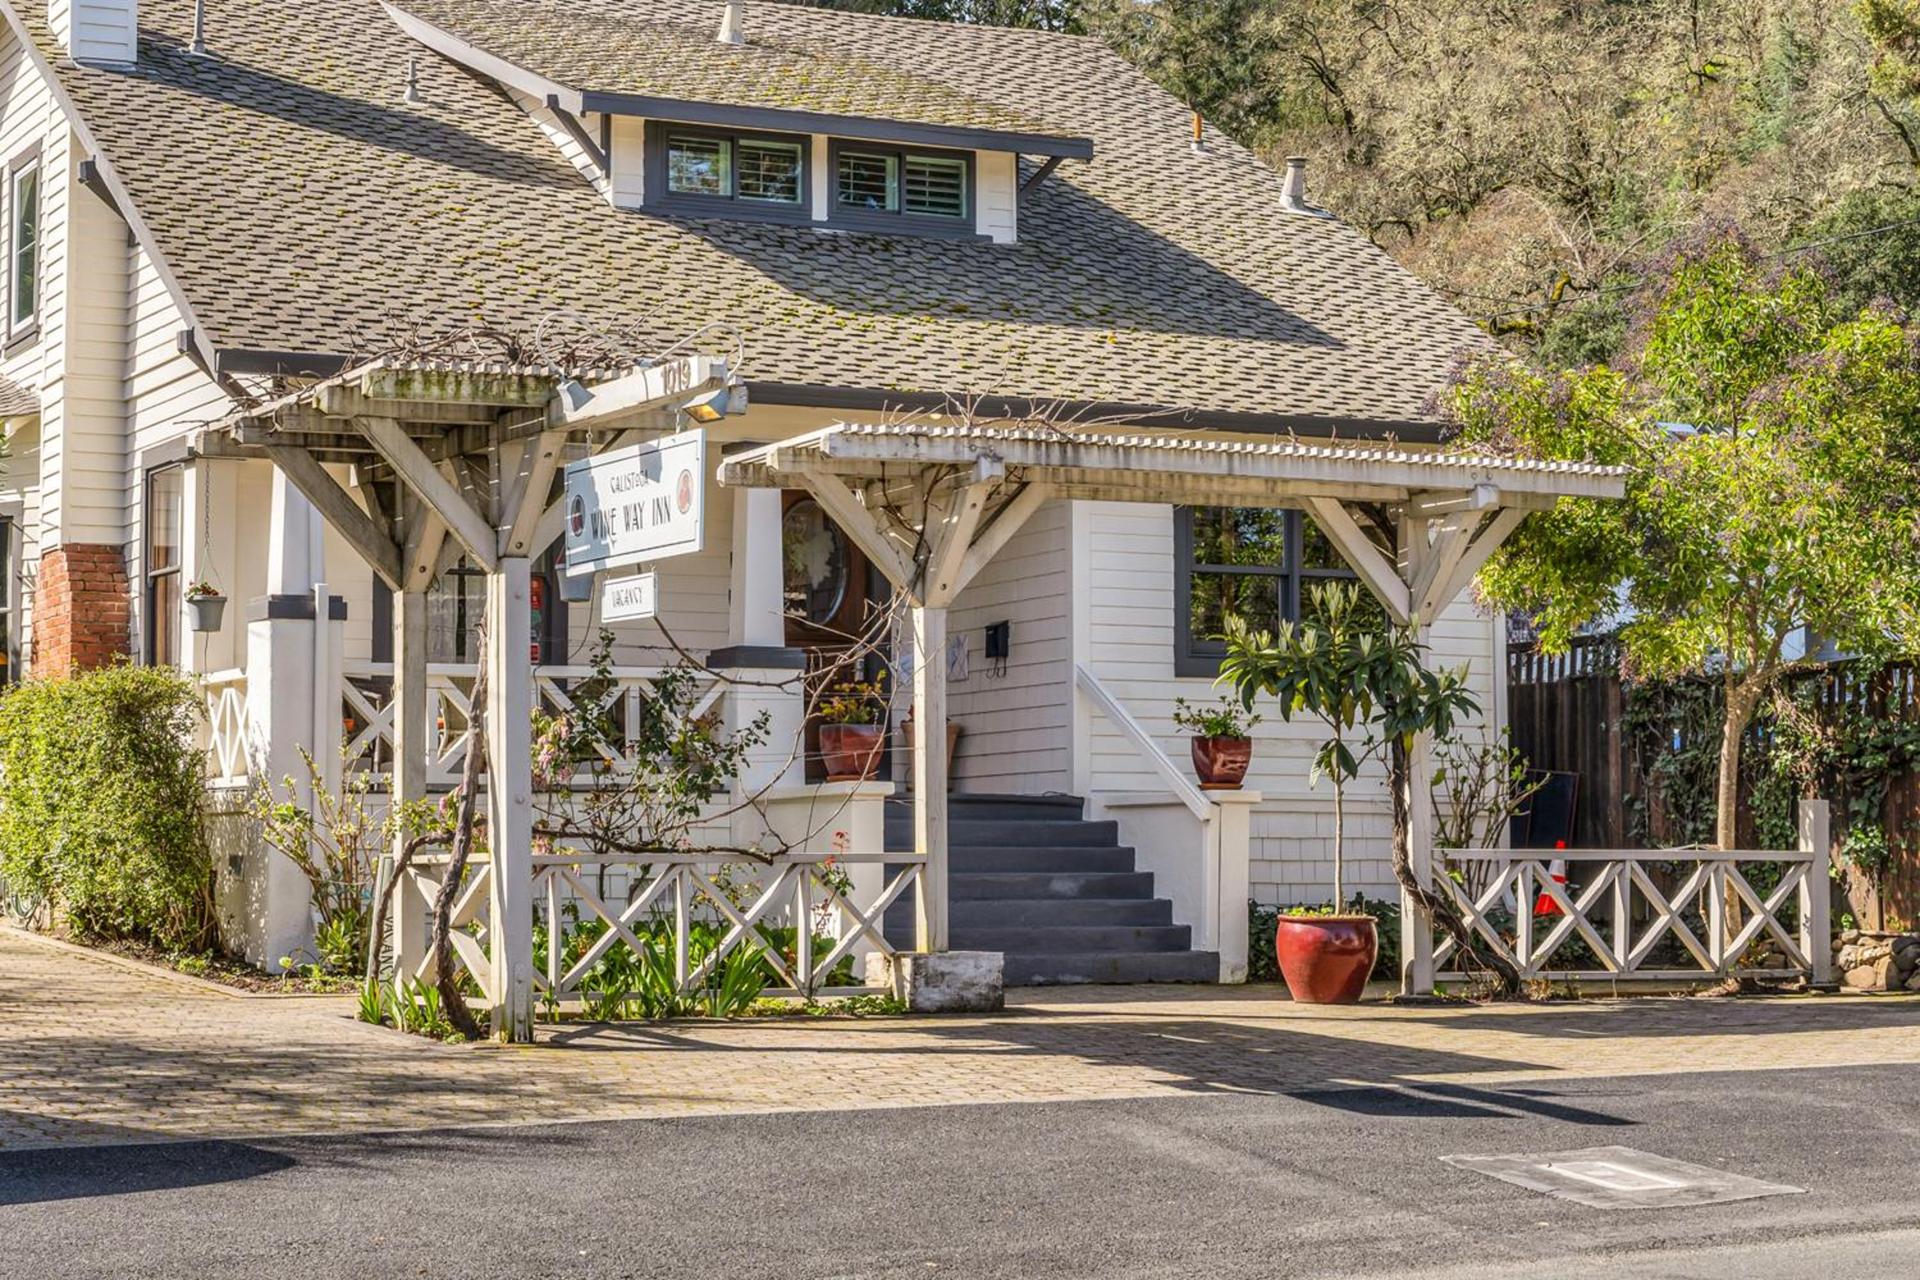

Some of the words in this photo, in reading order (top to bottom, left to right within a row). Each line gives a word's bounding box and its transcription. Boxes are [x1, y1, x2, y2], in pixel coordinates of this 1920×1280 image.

[661, 360, 691, 395] 1019
[610, 469, 649, 494] CALISTOGA
[591, 507, 617, 540] WINE
[623, 502, 645, 533] WAY
[652, 495, 672, 527] INN
[611, 587, 642, 608] VACANCY
[379, 915, 394, 984] VACANCY
